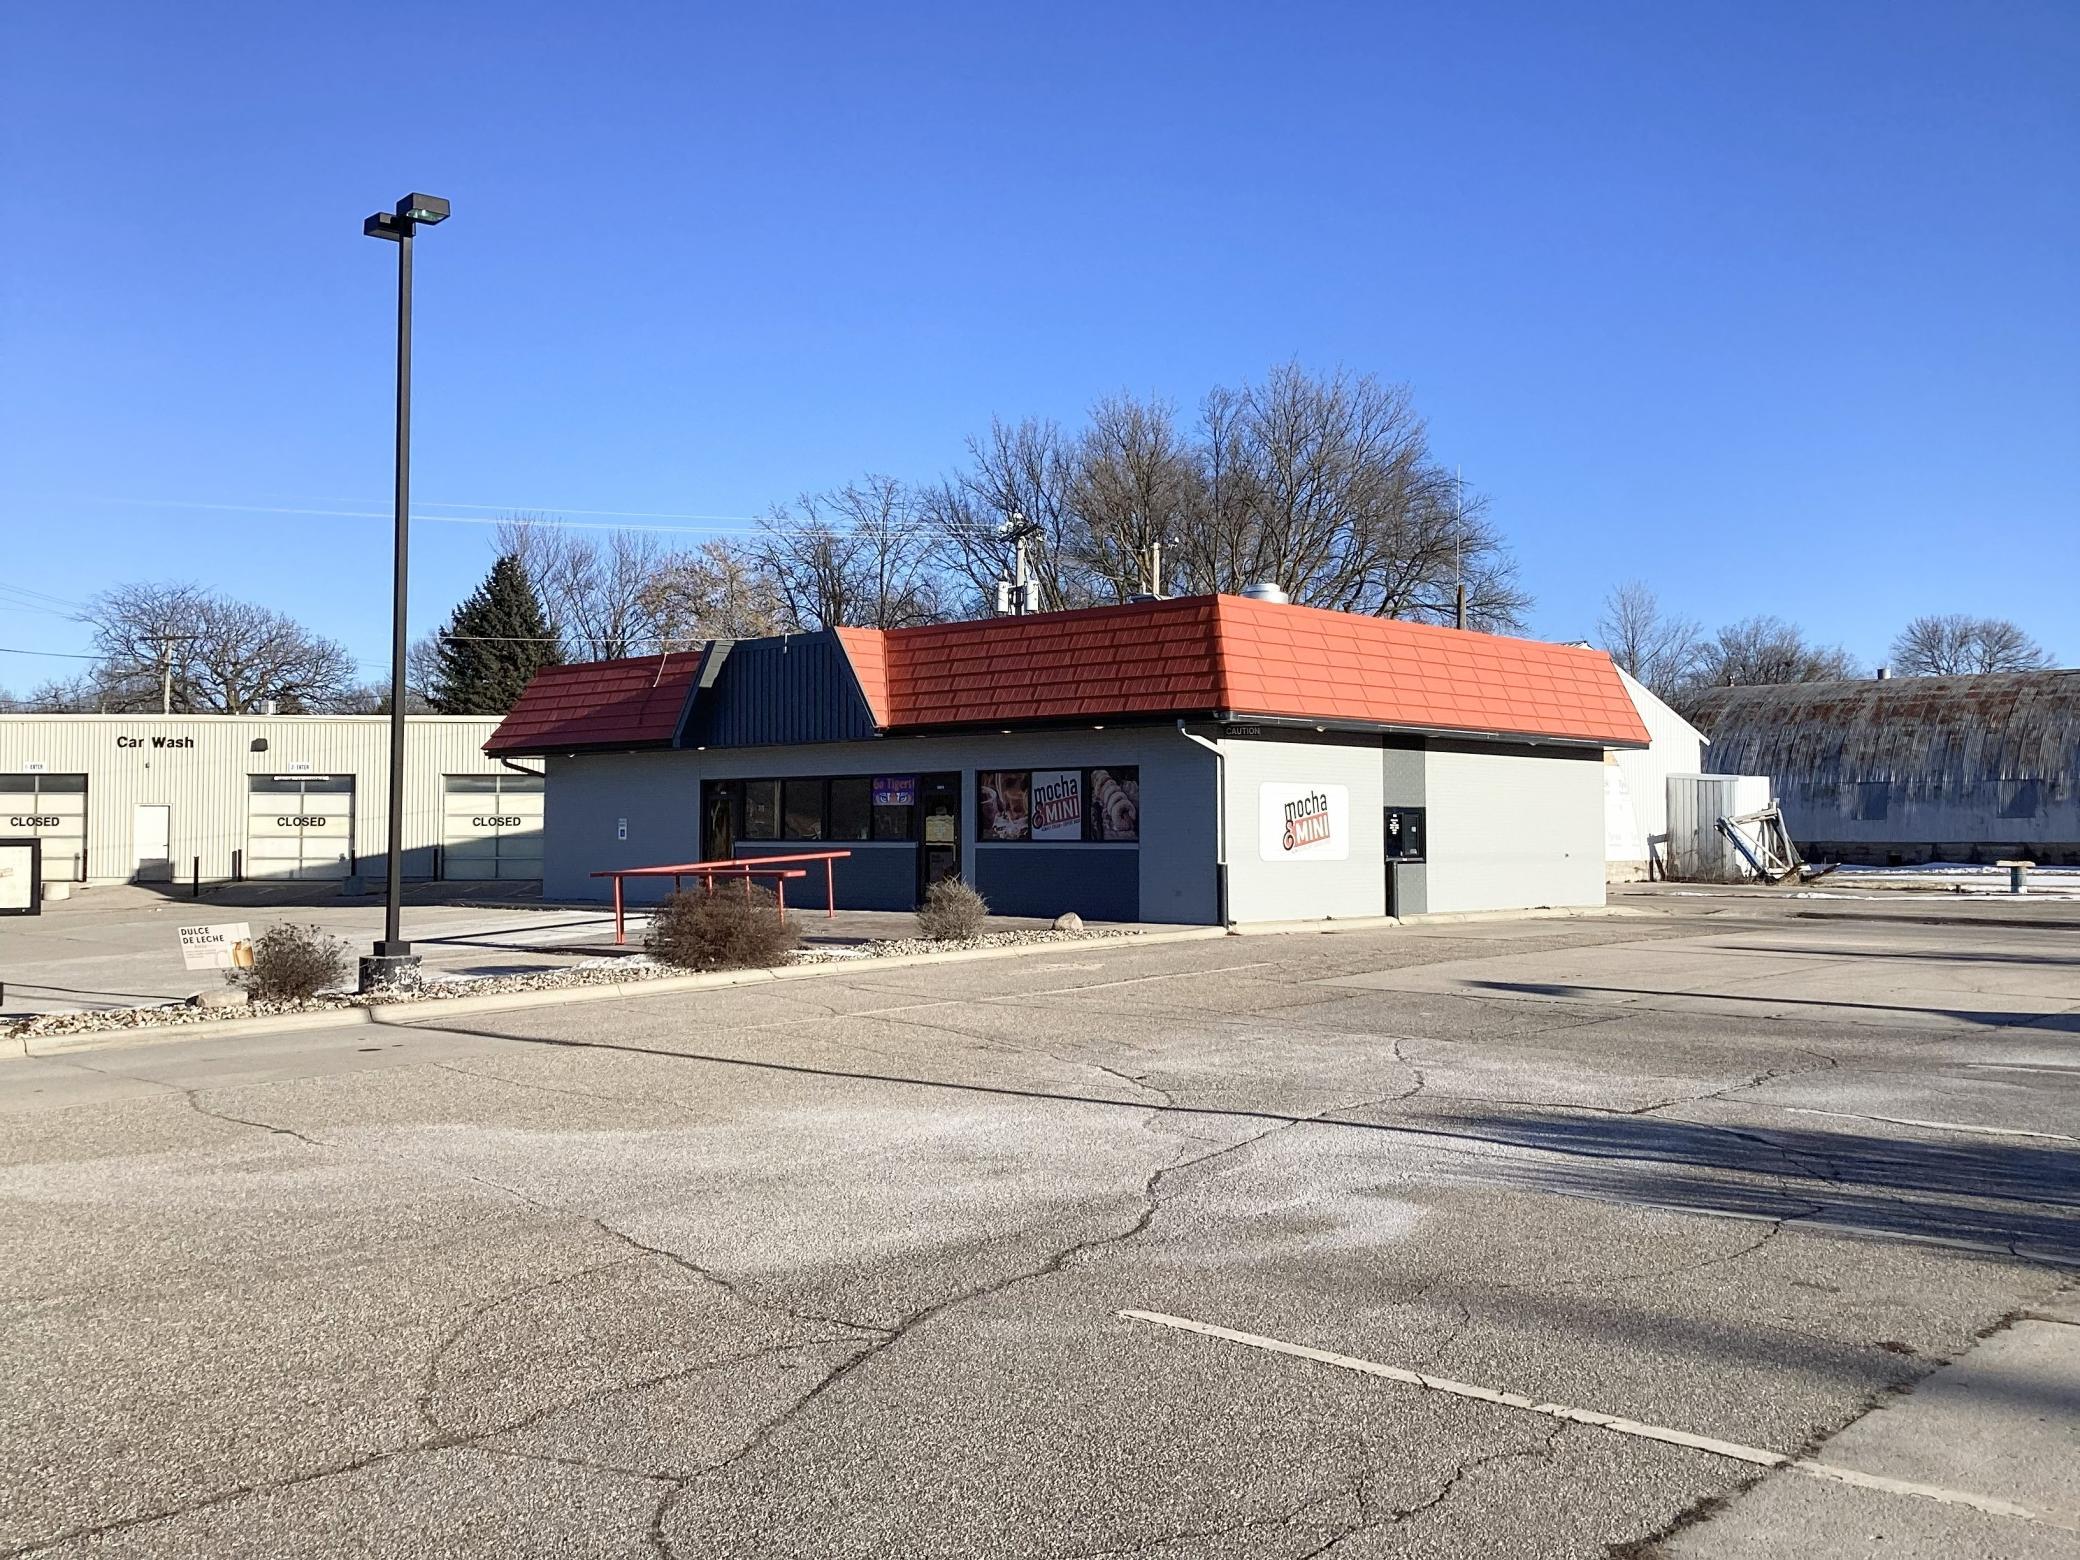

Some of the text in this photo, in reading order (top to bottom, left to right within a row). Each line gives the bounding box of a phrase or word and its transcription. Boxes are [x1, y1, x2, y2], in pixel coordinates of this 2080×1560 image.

[1226, 727, 1260, 735] CAUTION
[117, 736, 194, 748] Car Wash
[1034, 775, 1078, 803] mocha
[1045, 798, 1079, 823] MINI
[1284, 790, 1328, 820] mocha
[10, 817, 60, 827] CLOSED
[277, 817, 326, 827] CLOSED
[472, 816, 521, 827] CLOSED
[1295, 814, 1329, 844] MINI
[180, 927, 210, 936] DULCE
[183, 935, 224, 945] DE LECHE
